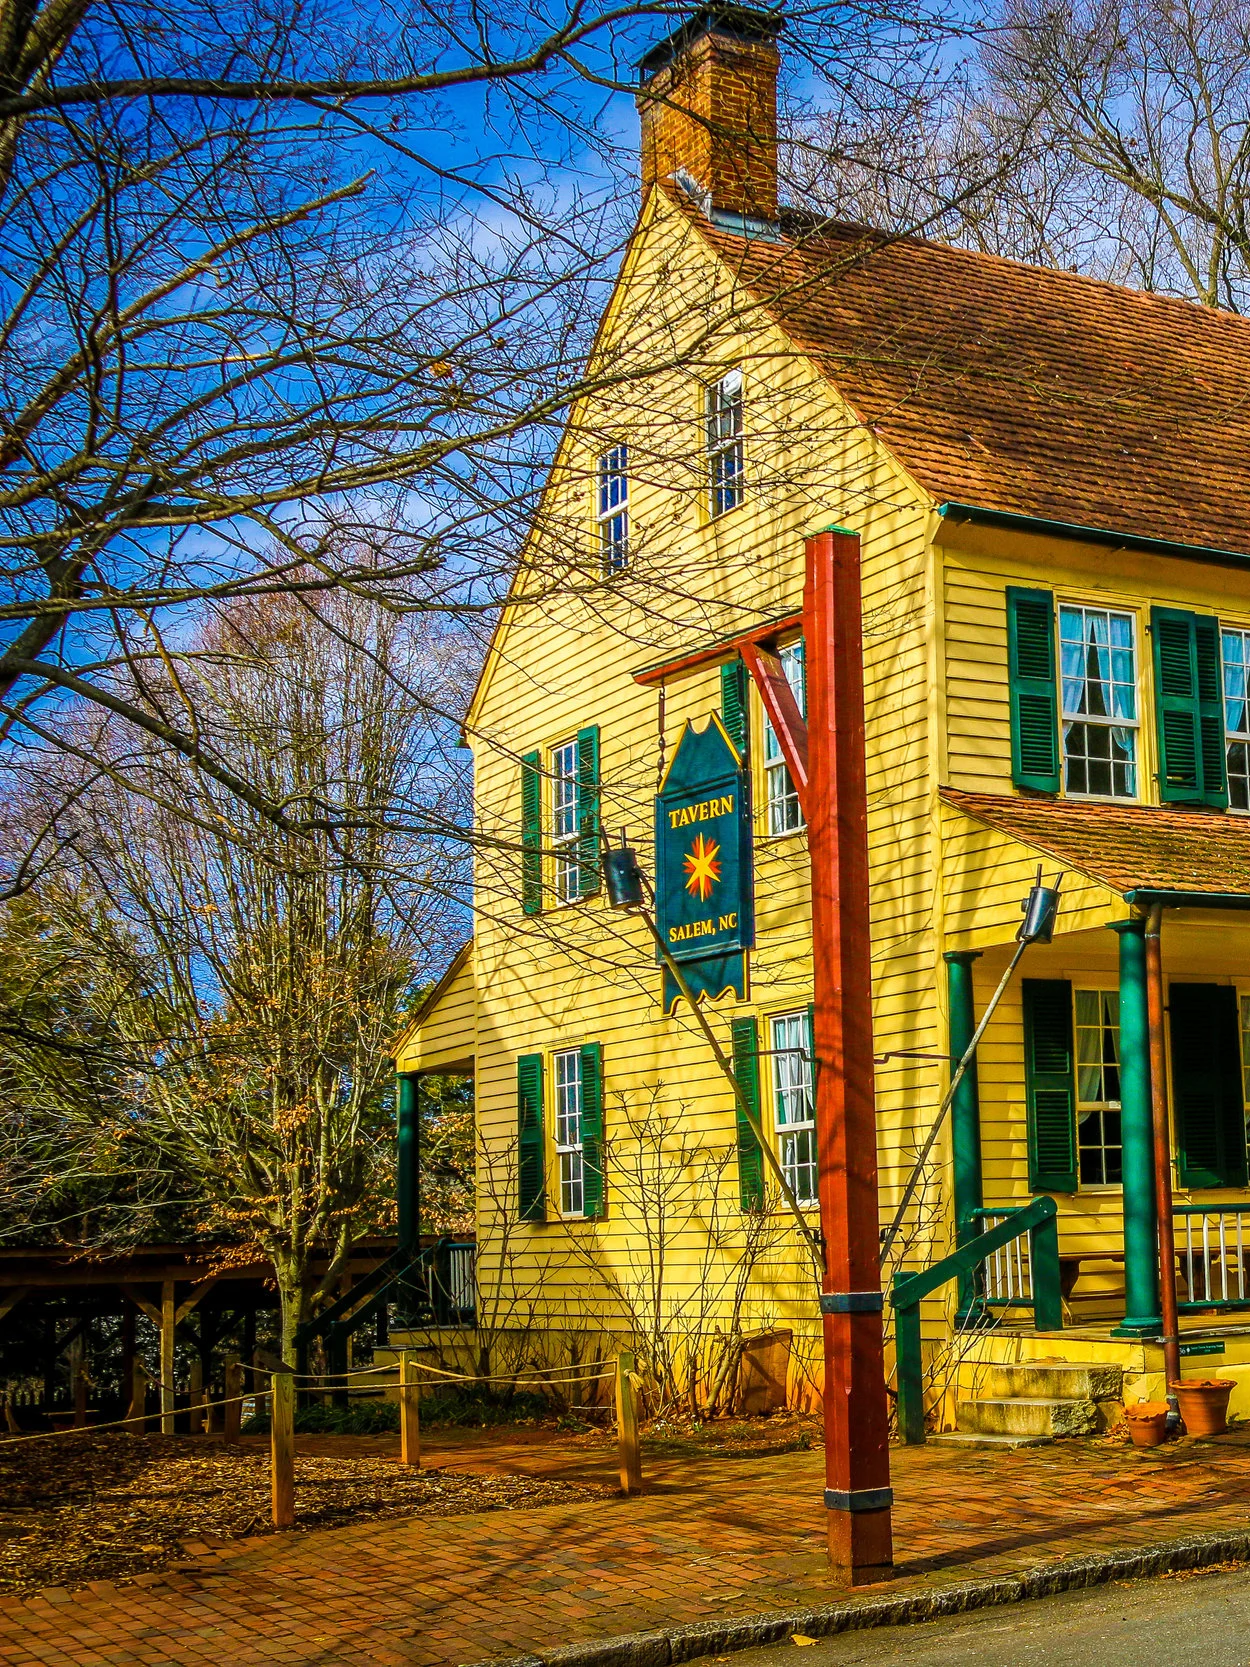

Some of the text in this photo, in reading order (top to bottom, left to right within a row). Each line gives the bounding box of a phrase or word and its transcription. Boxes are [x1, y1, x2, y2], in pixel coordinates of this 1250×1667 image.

[668, 795, 733, 829] TAVERN
[669, 912, 737, 942] SALEM, NC
